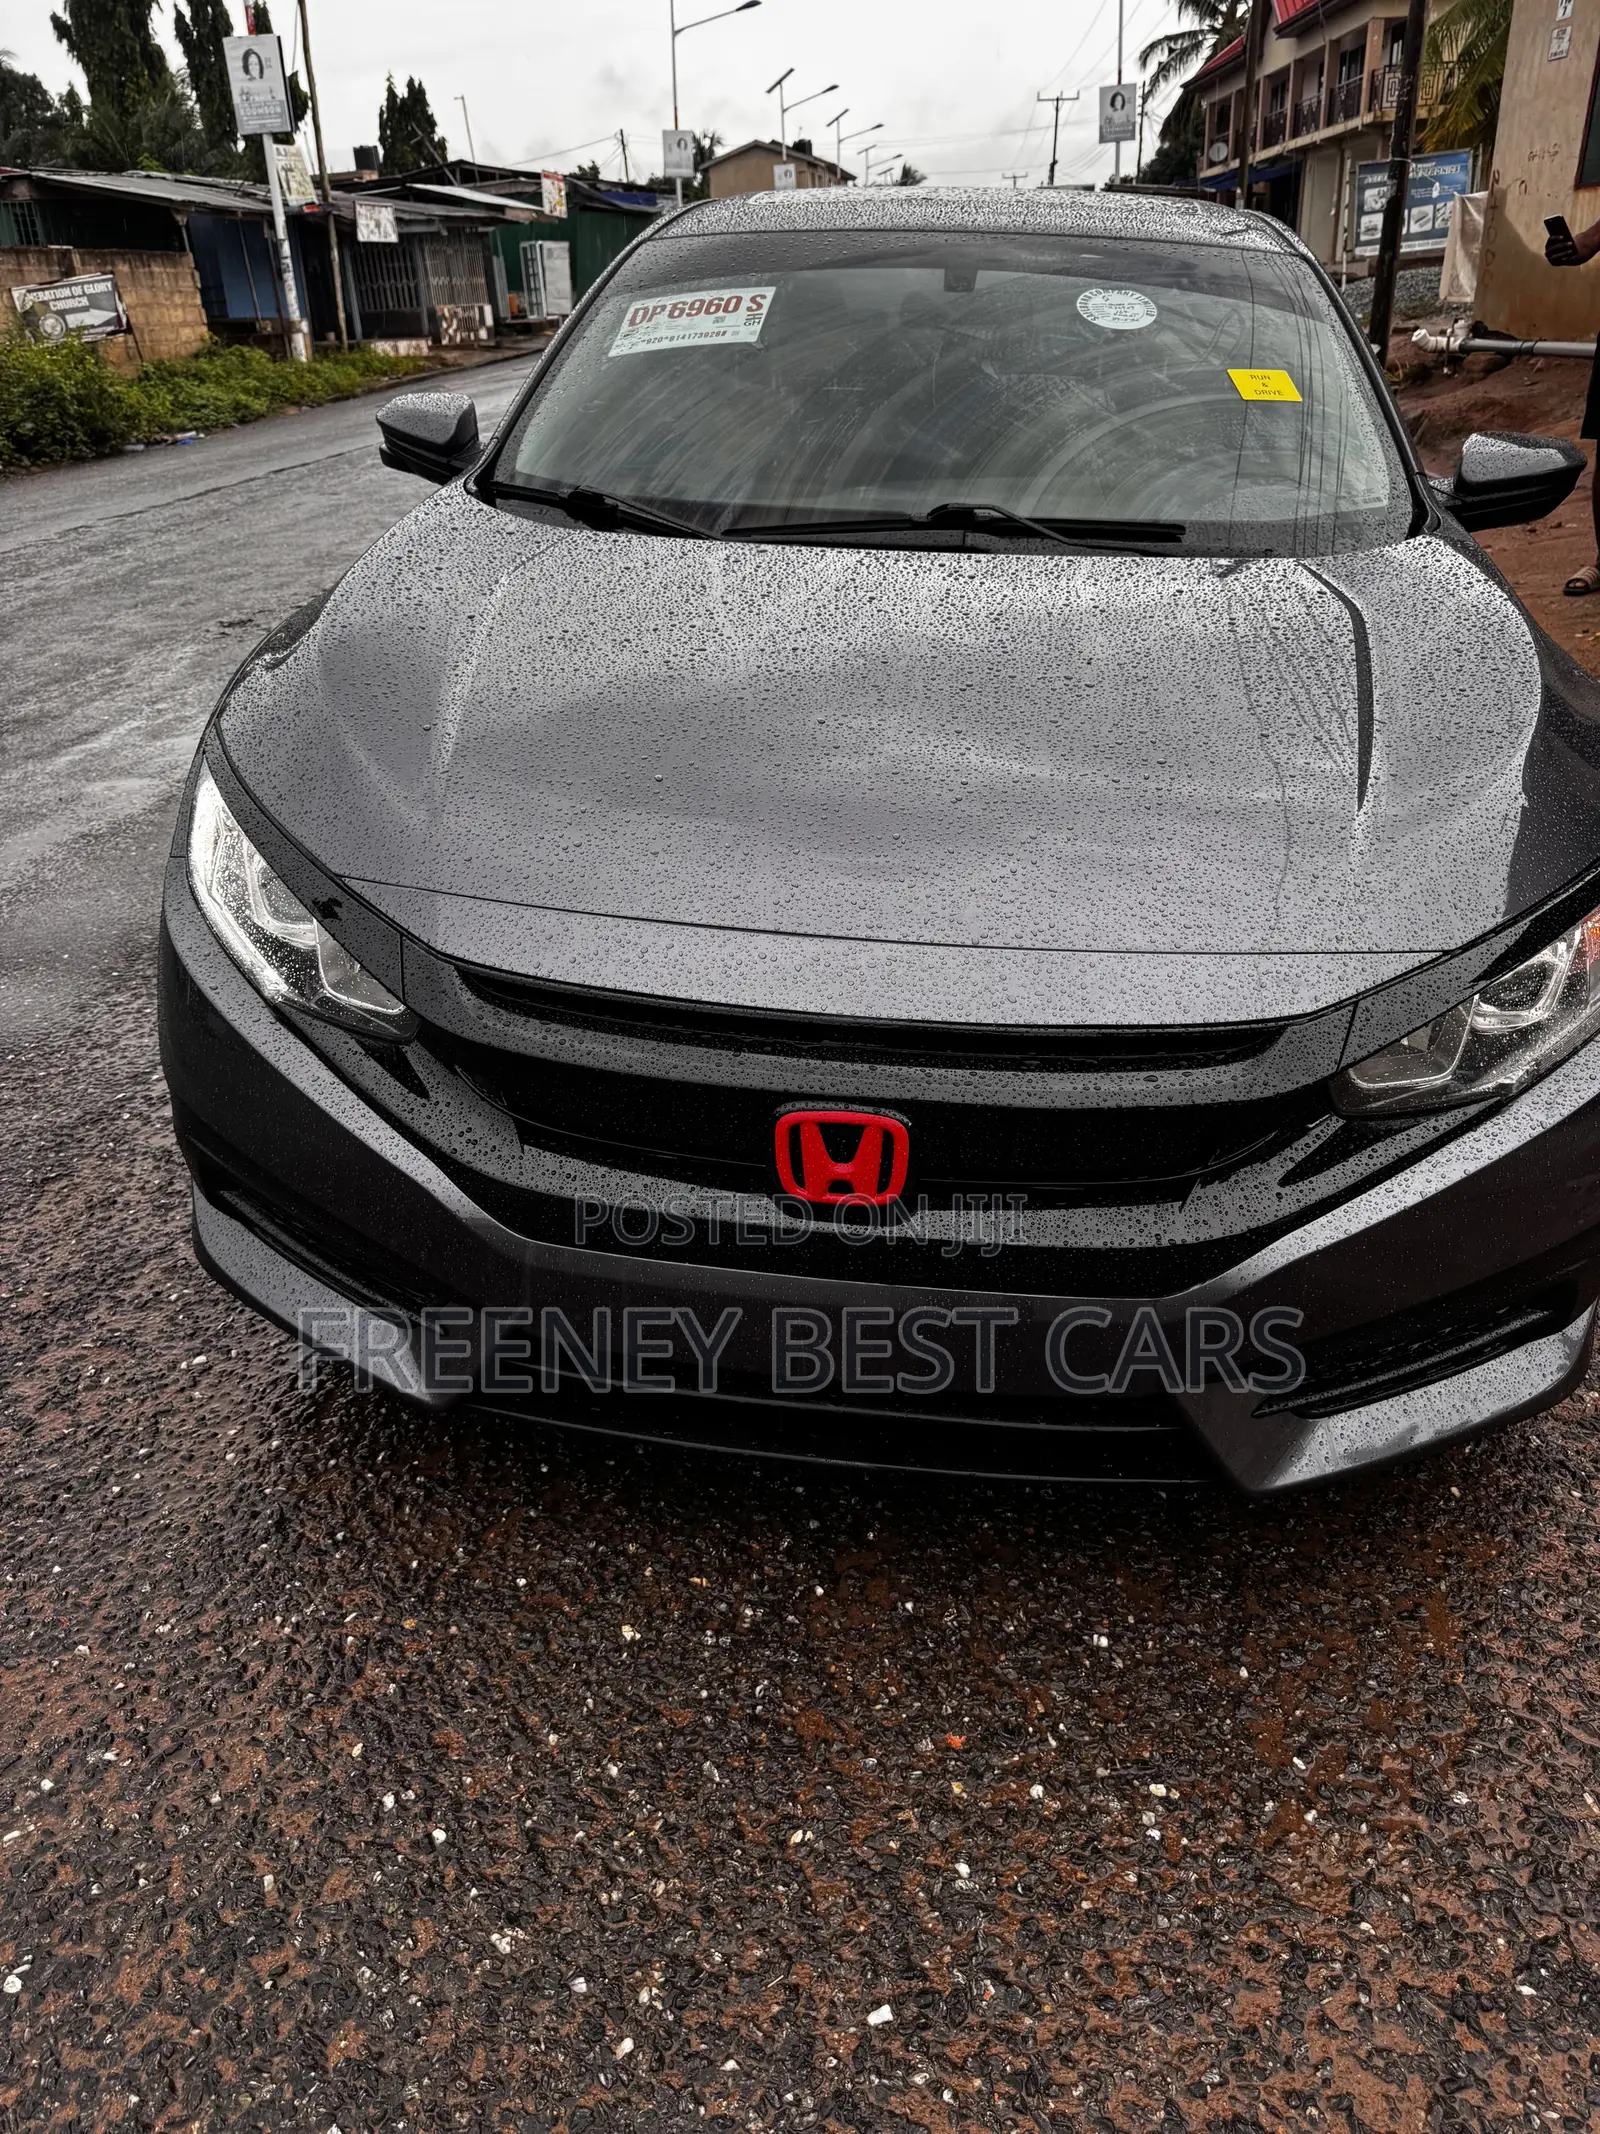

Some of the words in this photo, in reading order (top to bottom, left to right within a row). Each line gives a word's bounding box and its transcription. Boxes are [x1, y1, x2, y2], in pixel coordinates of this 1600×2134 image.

[72, 284, 83, 297] OF
[83, 281, 113, 295] GLORY
[49, 296, 90, 312] CHURCH
[628, 304, 667, 327] DP
[667, 295, 743, 319] 6960
[746, 294, 767, 312] S
[743, 319, 761, 327] GH
